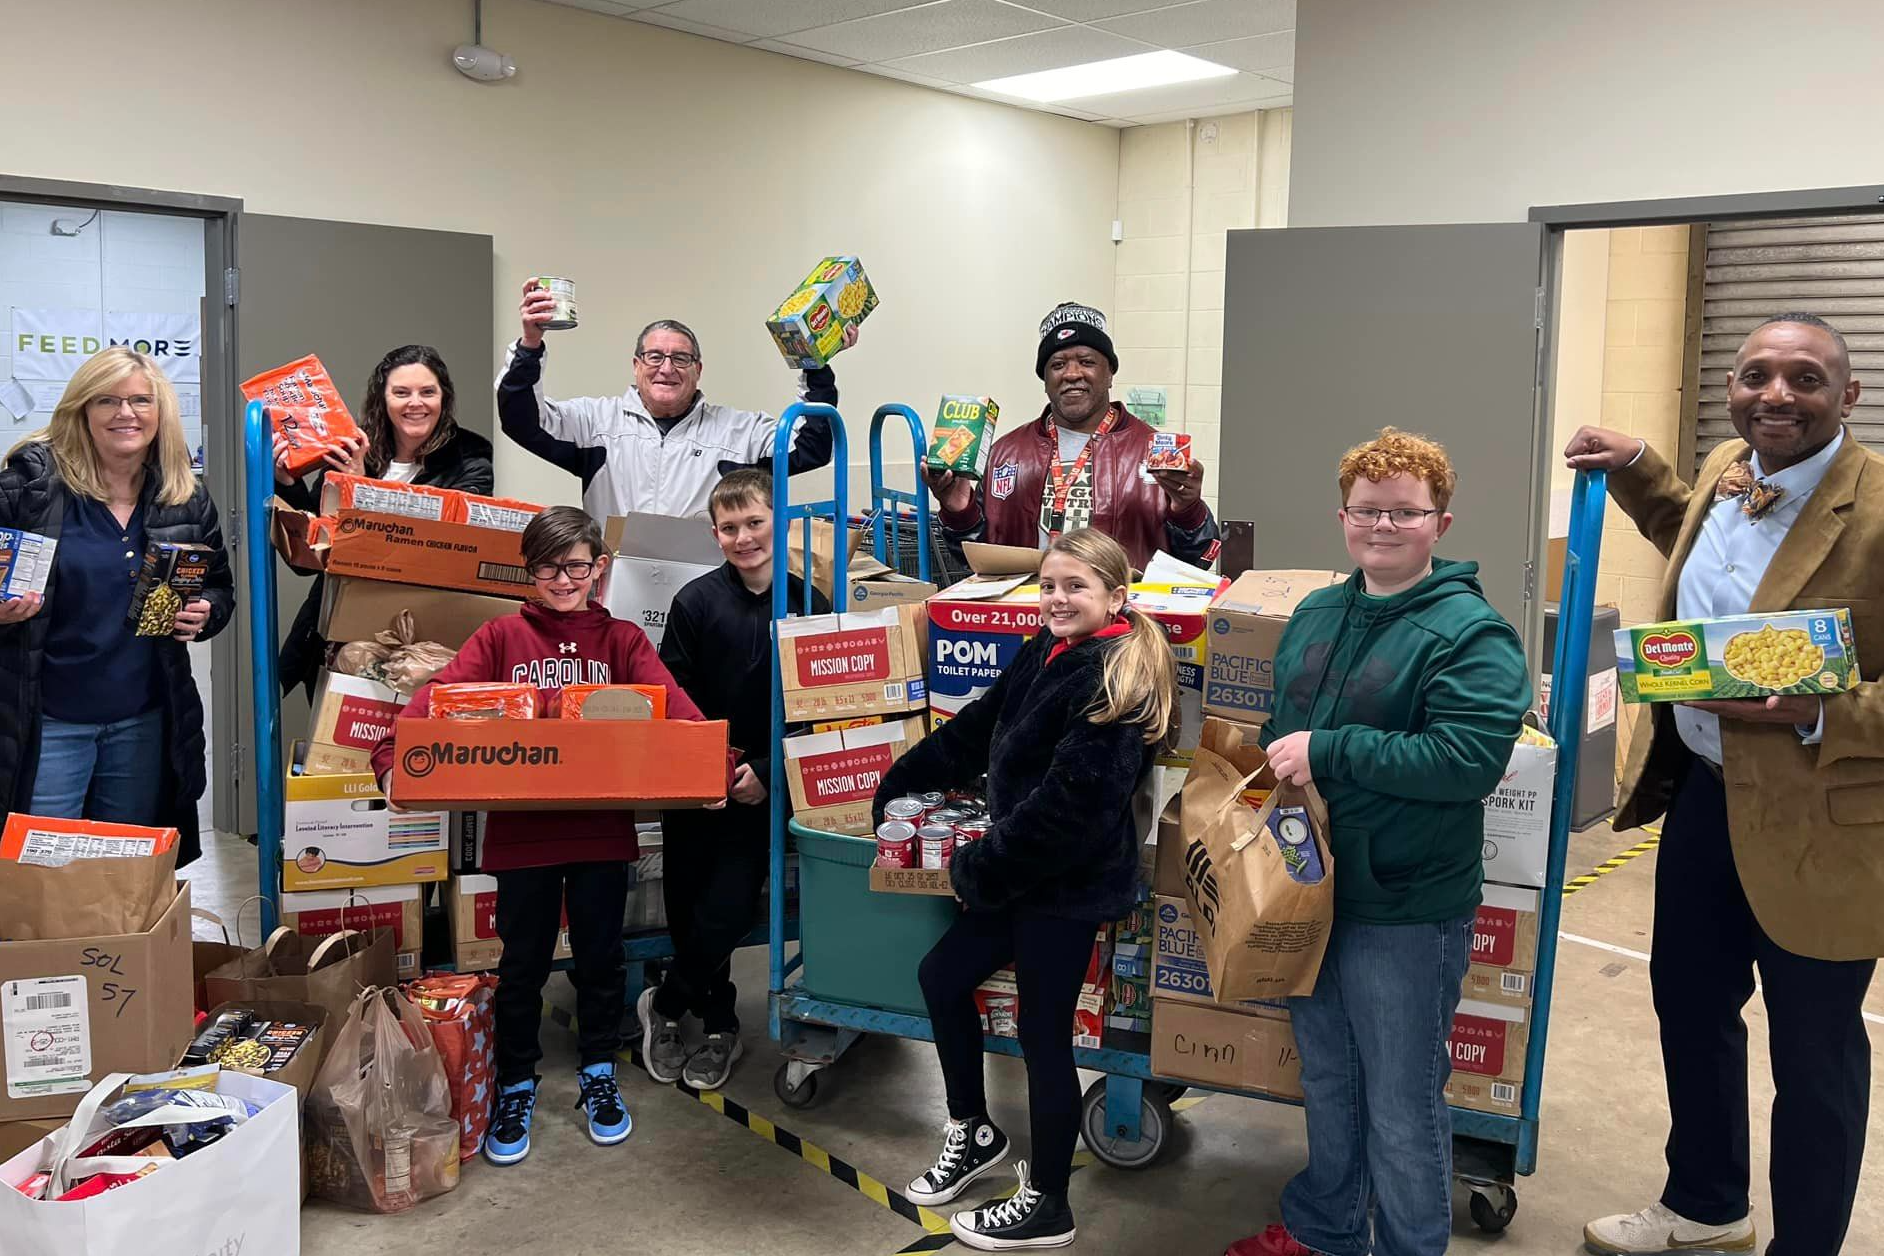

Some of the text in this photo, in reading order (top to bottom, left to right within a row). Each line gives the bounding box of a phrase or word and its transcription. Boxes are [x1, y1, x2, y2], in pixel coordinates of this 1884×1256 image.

[18, 334, 100, 354] FEED
[943, 400, 980, 420] CLUB
[354, 518, 414, 536] Maruchan
[385, 534, 424, 547] Ramen
[952, 609, 987, 624] Over
[1814, 620, 1827, 632] 8
[1167, 623, 1182, 634] se
[936, 640, 996, 666] POM
[1644, 642, 1694, 654] Del Monte
[512, 658, 611, 689] CAROLIN
[810, 656, 848, 676] MISSION
[851, 654, 874, 672] COPY
[937, 666, 970, 676] TOILET
[1212, 653, 1272, 674] PACIFIC
[1211, 666, 1248, 684] BLUE
[1210, 686, 1266, 707] 26301
[350, 721, 391, 741] MISSIO
[430, 742, 558, 765] Maruchan
[344, 784, 356, 793] LLI
[816, 770, 880, 796] MISSION COPY
[1528, 790, 1538, 798] PP
[1519, 800, 1536, 811] KIT
[1159, 927, 1200, 942] PACIF
[1472, 933, 1496, 954] OPY
[1159, 940, 1194, 956] BLUE
[80, 948, 124, 976] SOL
[102, 983, 136, 1018] 57
[1456, 1042, 1486, 1064] COPY
